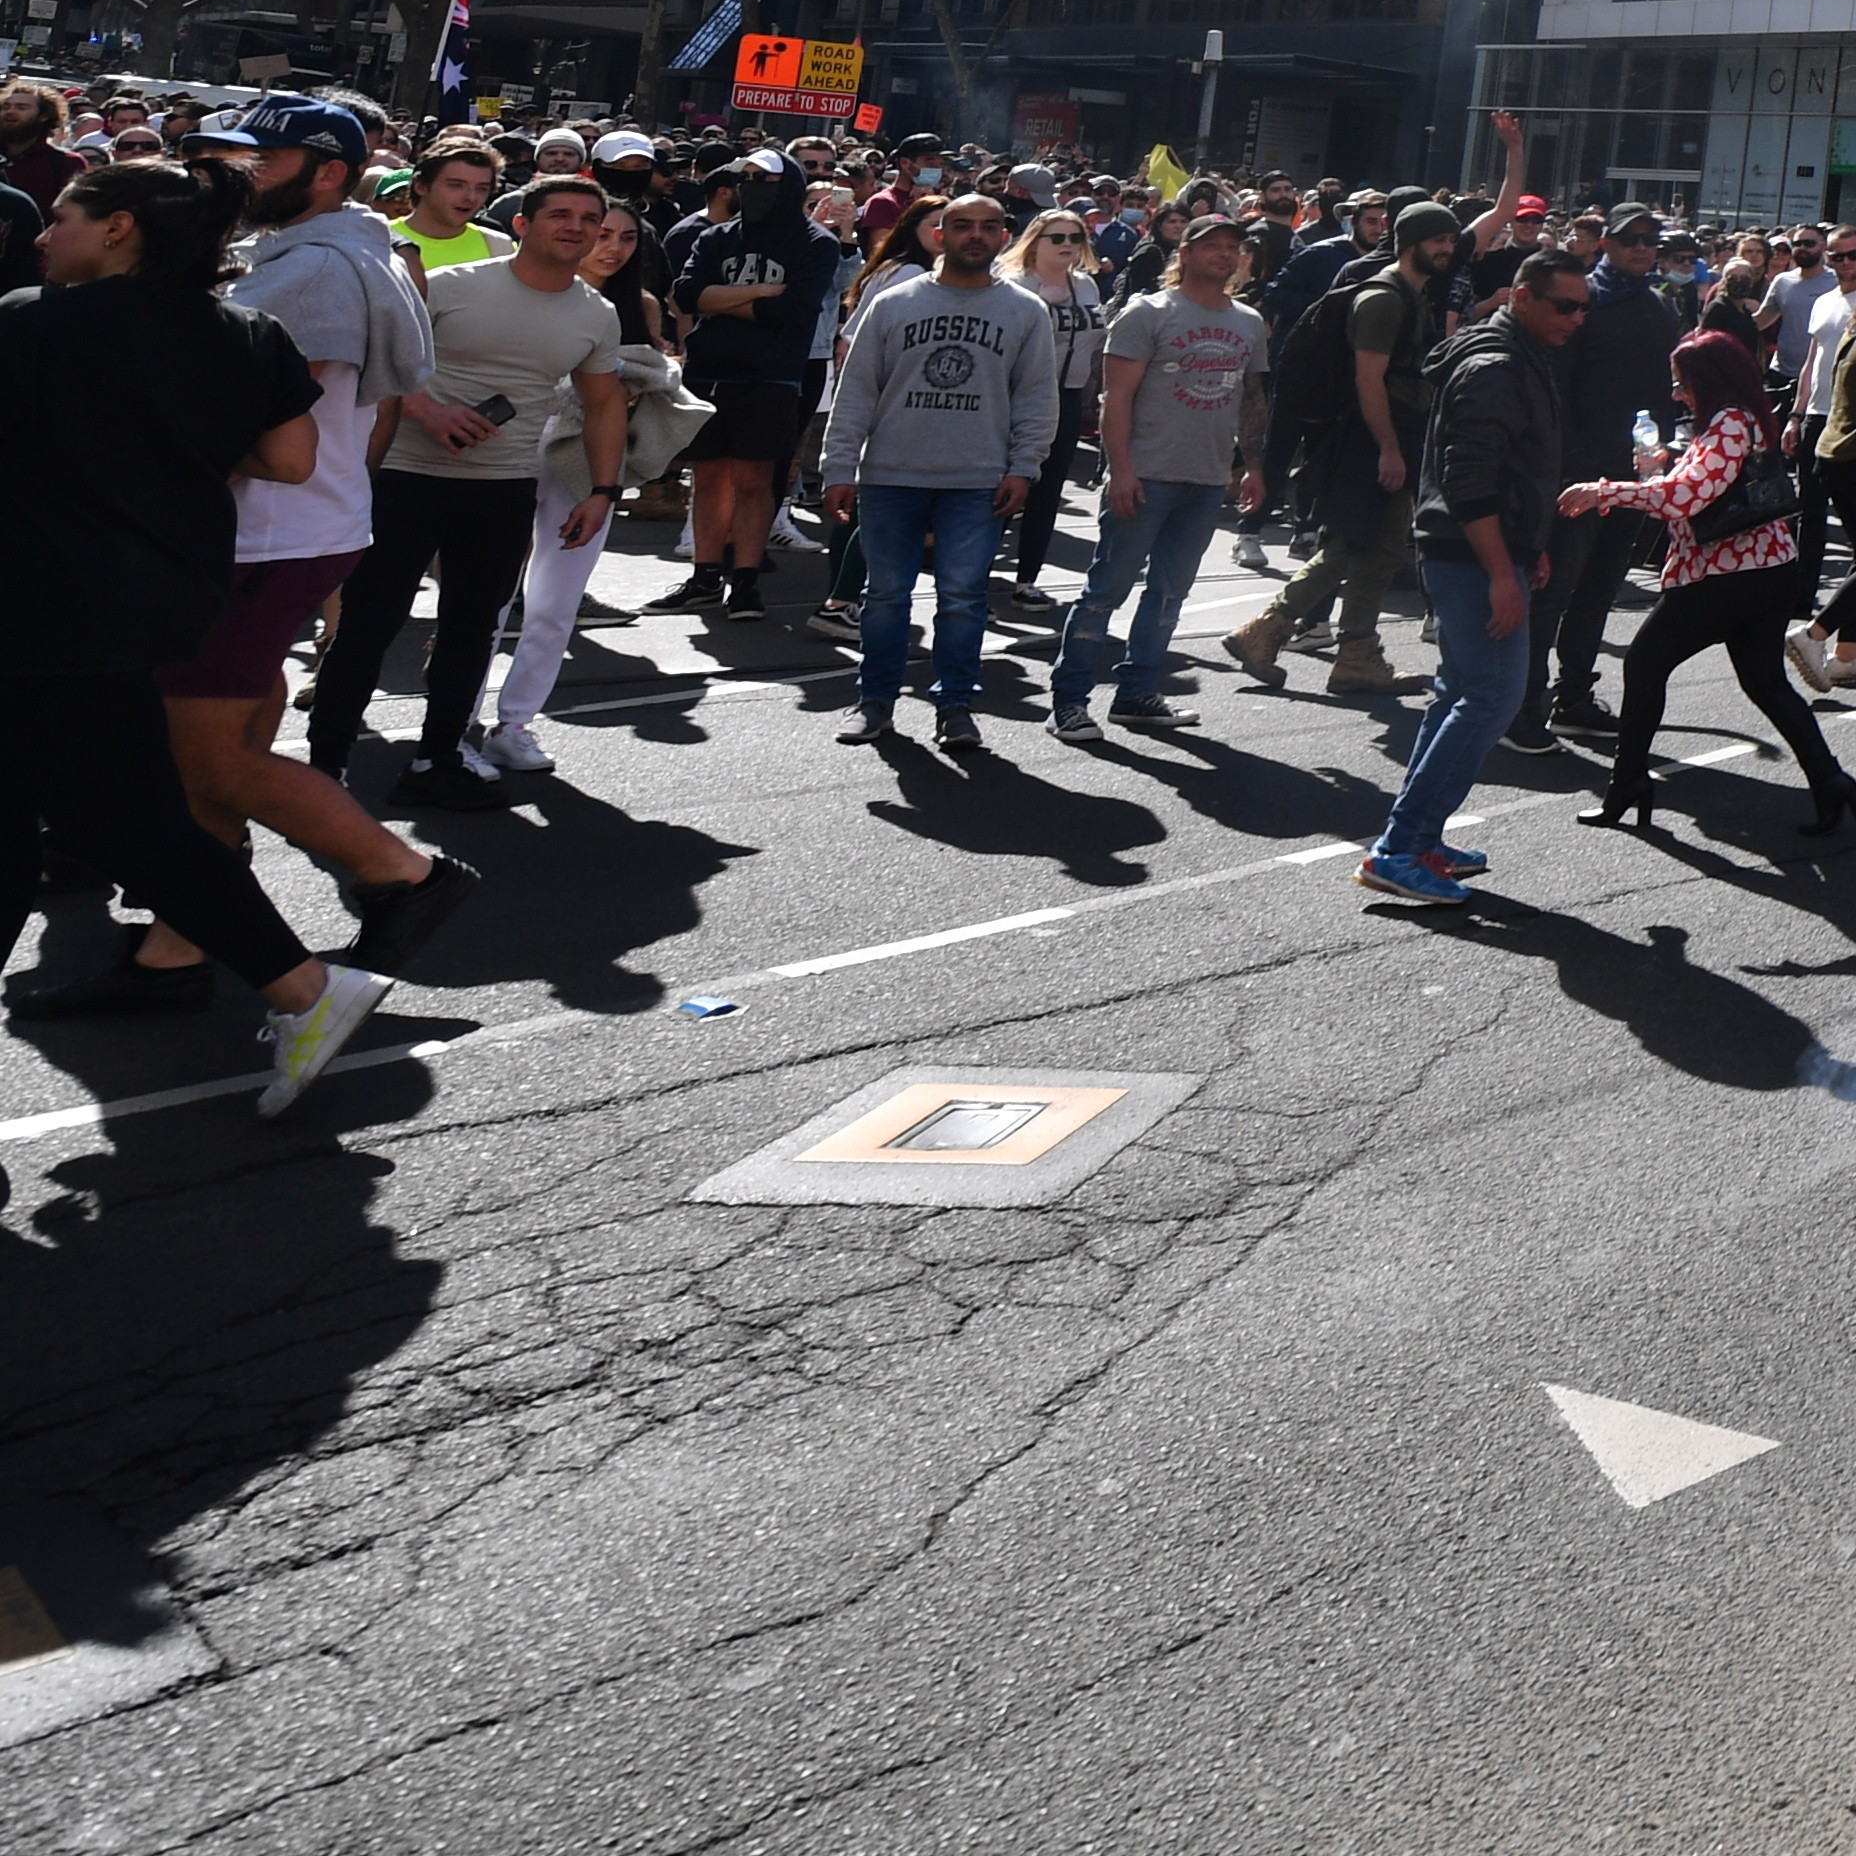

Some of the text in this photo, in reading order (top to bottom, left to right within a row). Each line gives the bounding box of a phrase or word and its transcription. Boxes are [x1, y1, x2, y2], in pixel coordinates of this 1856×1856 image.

[813, 45, 855, 60] ROAD
[811, 61, 853, 75] WORK
[802, 75, 855, 90] AHEAD
[1727, 67, 1825, 95] VON
[736, 89, 851, 113] PREPARE TO STOP
[1024, 118, 1064, 137] RETAIL
[902, 315, 1004, 357] RUSSELL
[904, 391, 981, 412] ATHLETIC
